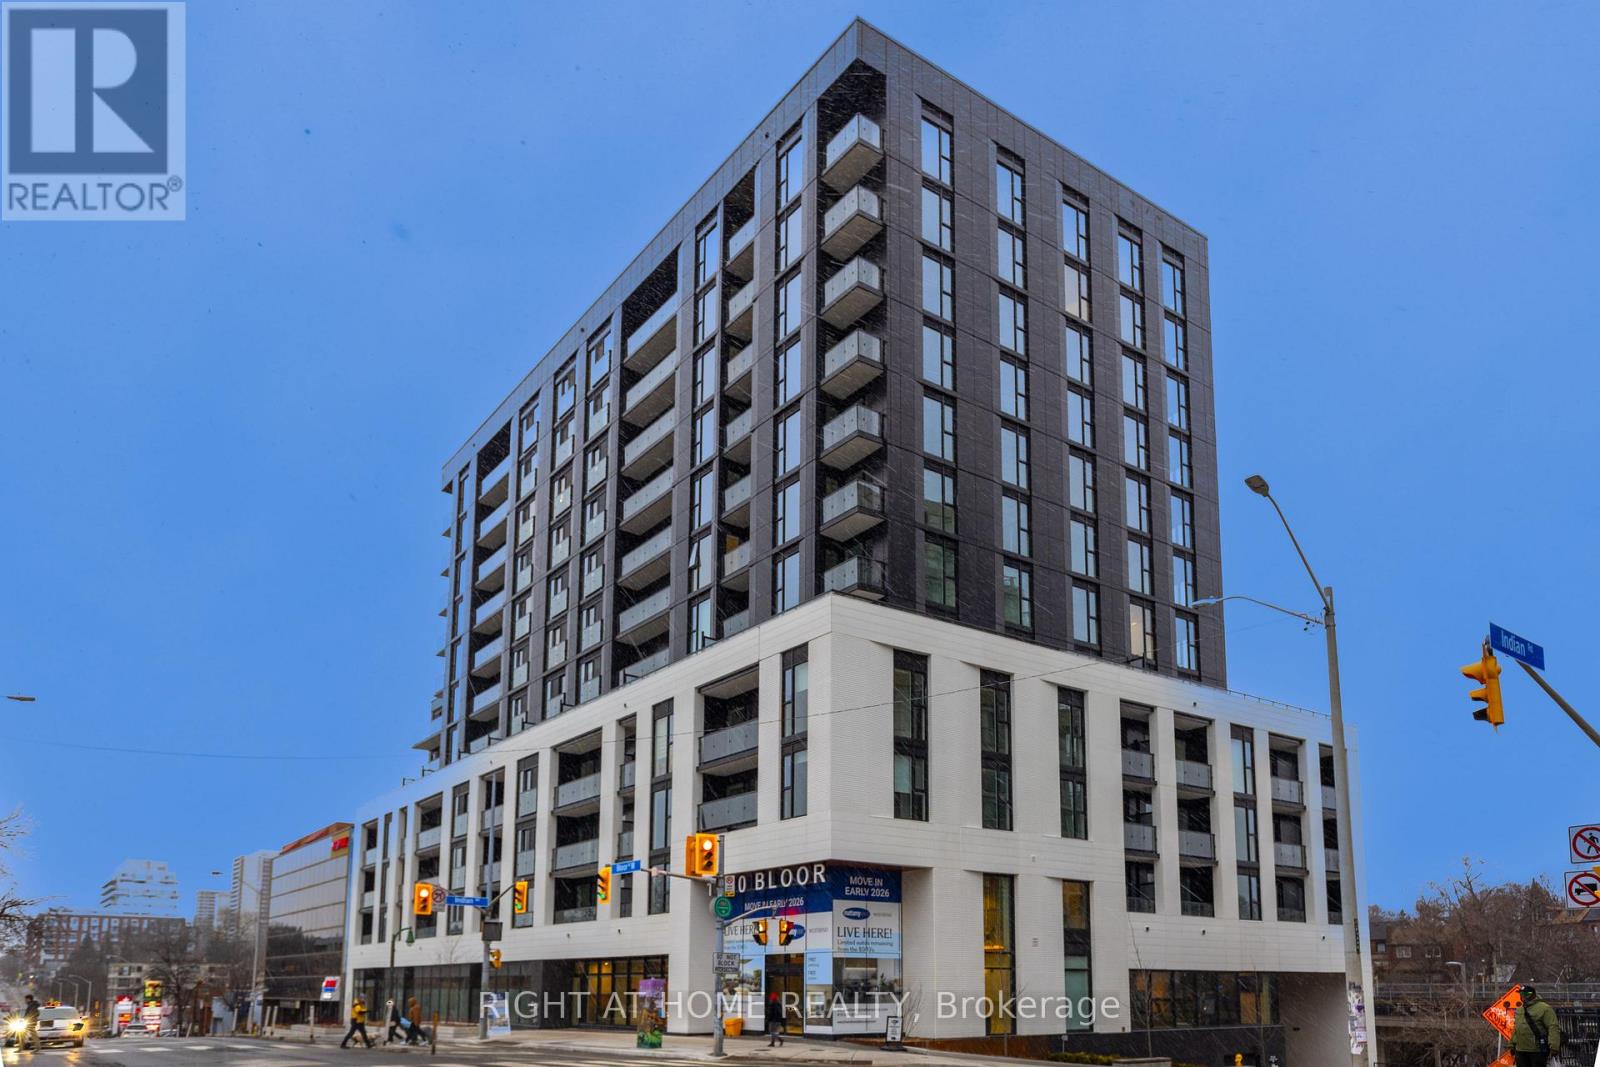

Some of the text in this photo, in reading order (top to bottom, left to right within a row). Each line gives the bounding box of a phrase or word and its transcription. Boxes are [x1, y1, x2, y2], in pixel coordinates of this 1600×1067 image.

[1501, 630, 1526, 657] Indian
[755, 863, 826, 891] BLOOR
[849, 876, 884, 887] MOVE IN
[845, 886, 890, 897] EARLY 2026
[788, 896, 805, 907] 2026
[837, 926, 860, 938] LIVE
[863, 927, 892, 939] HERE!
